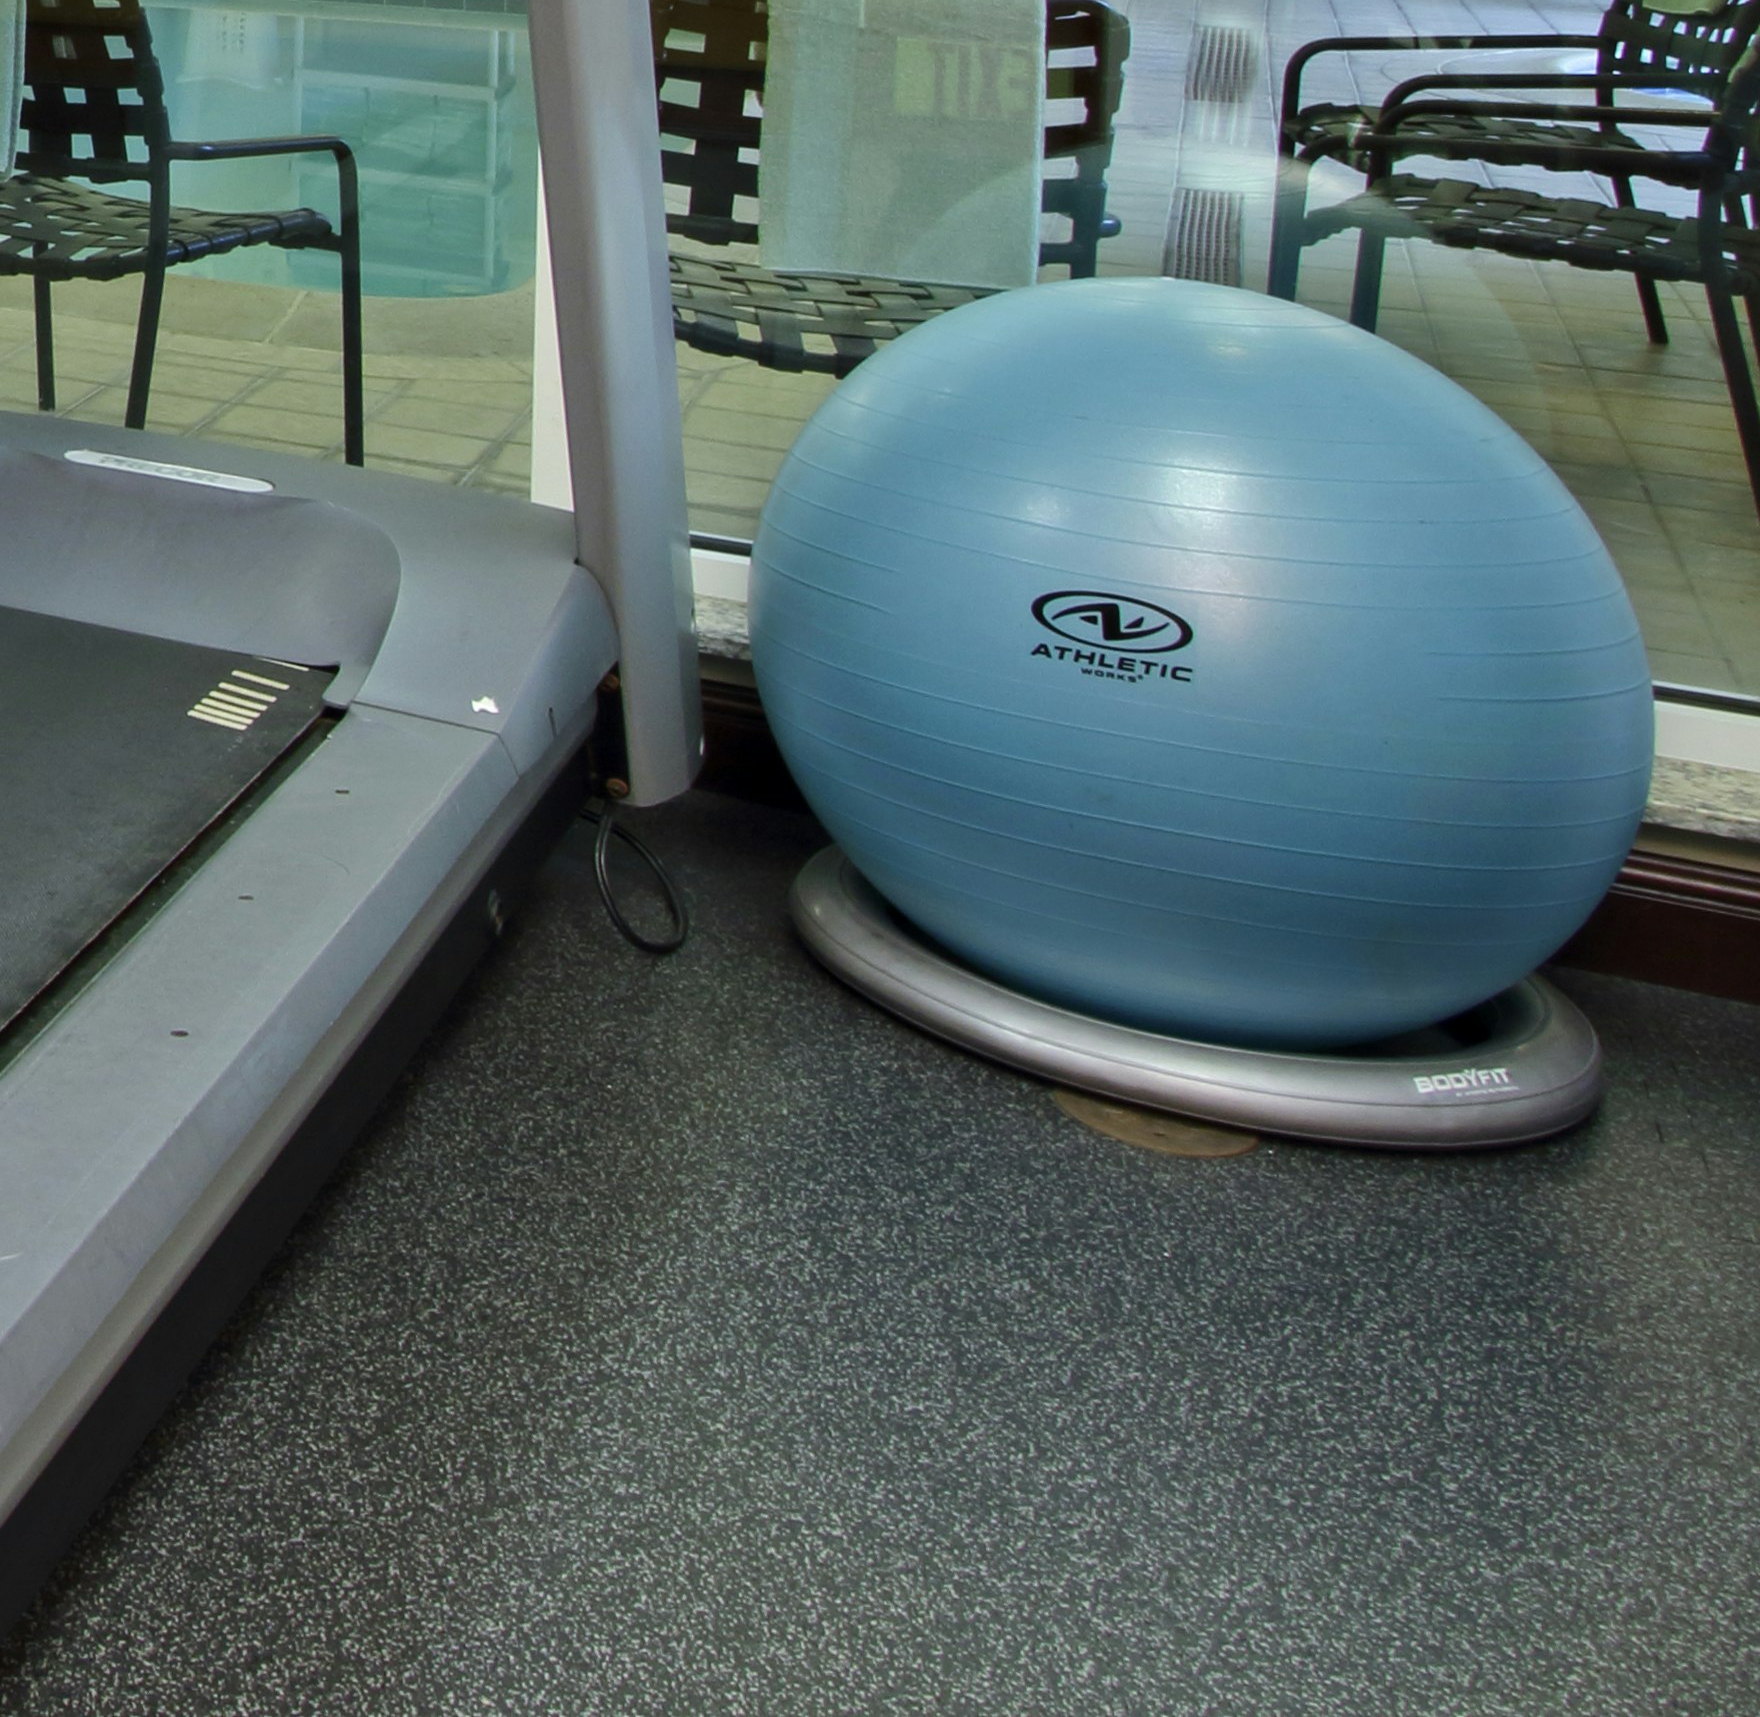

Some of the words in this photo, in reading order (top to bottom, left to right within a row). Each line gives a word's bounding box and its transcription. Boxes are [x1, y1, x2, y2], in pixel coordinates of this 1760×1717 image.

[1030, 642, 1193, 682] ATHLETIC
[1080, 667, 1137, 683] WORKS
[1413, 1067, 1508, 1093] BODYFIT
